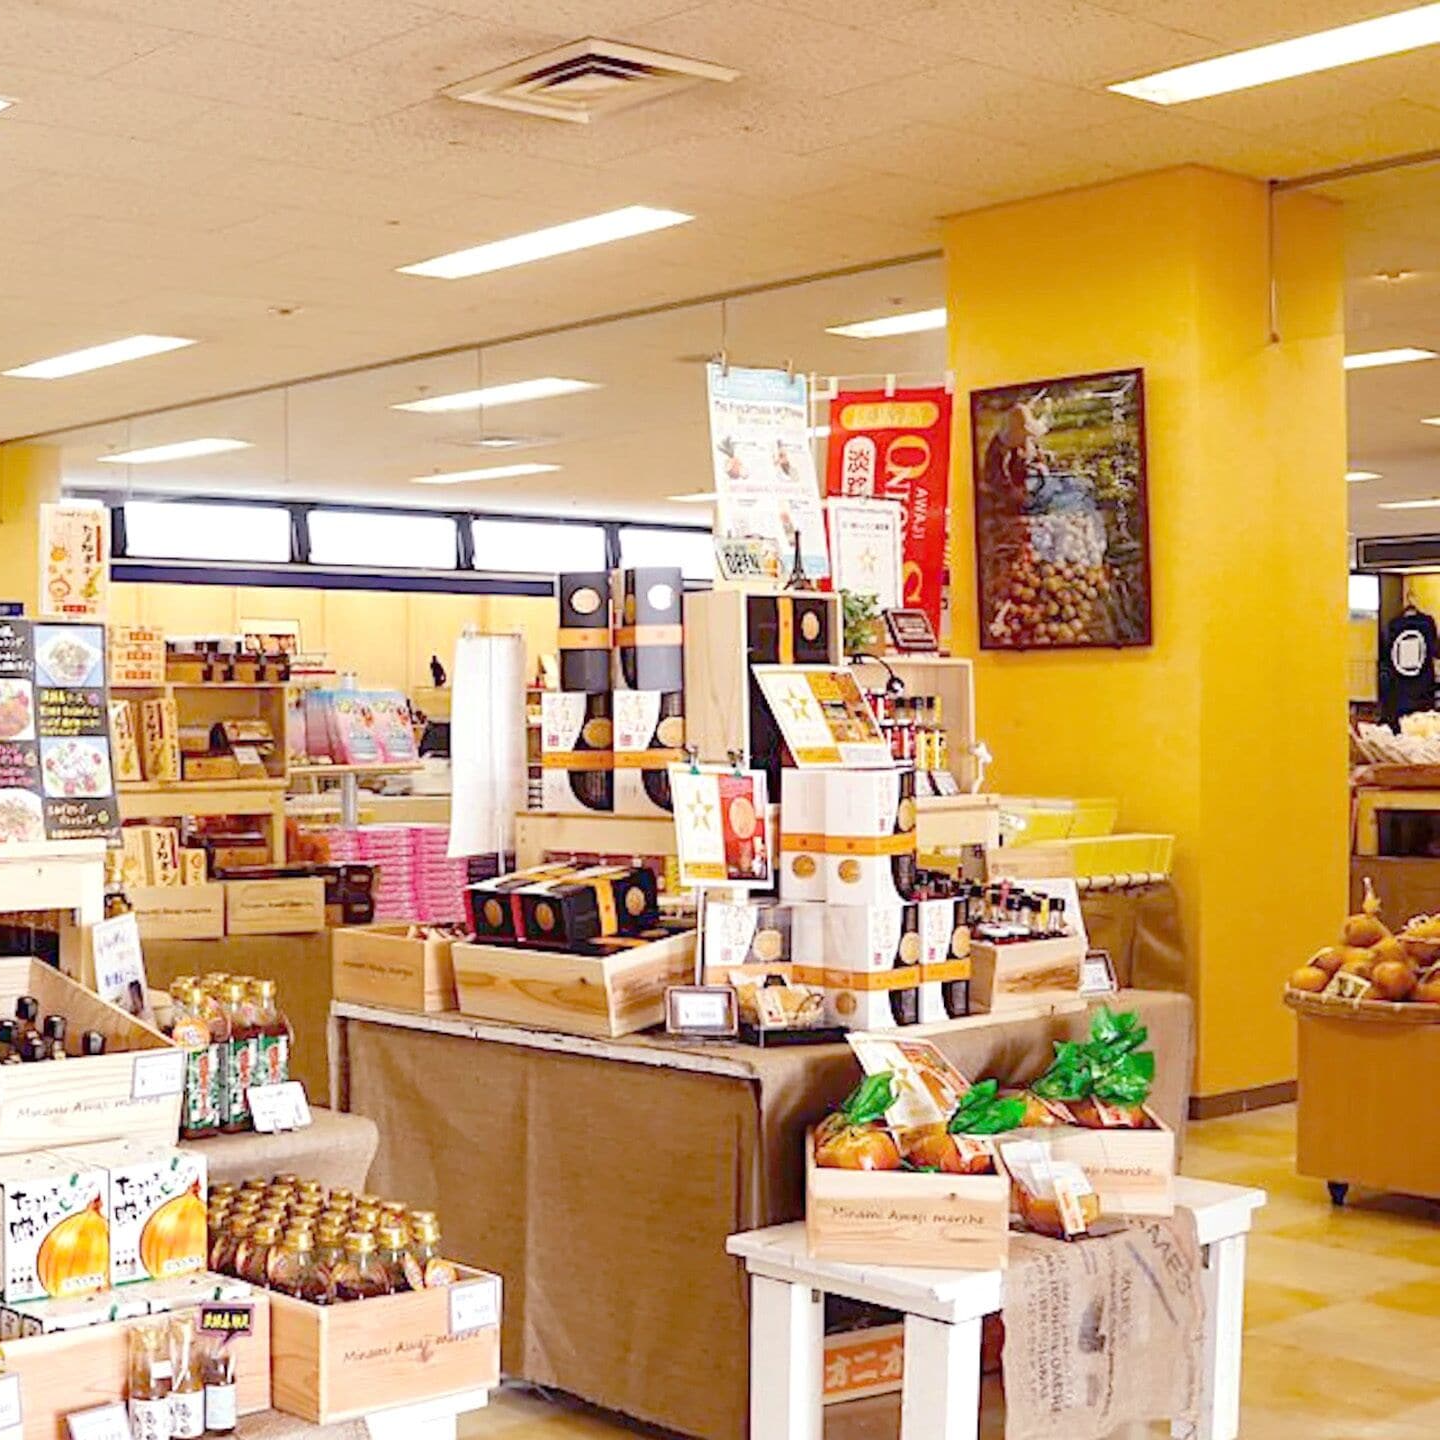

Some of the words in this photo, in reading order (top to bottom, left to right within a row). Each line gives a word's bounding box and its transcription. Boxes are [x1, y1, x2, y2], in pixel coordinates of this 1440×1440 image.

[912, 486, 930, 540] AWAJI
[887, 1209, 927, 1224] Awaji
[932, 1212, 984, 1225] marche
